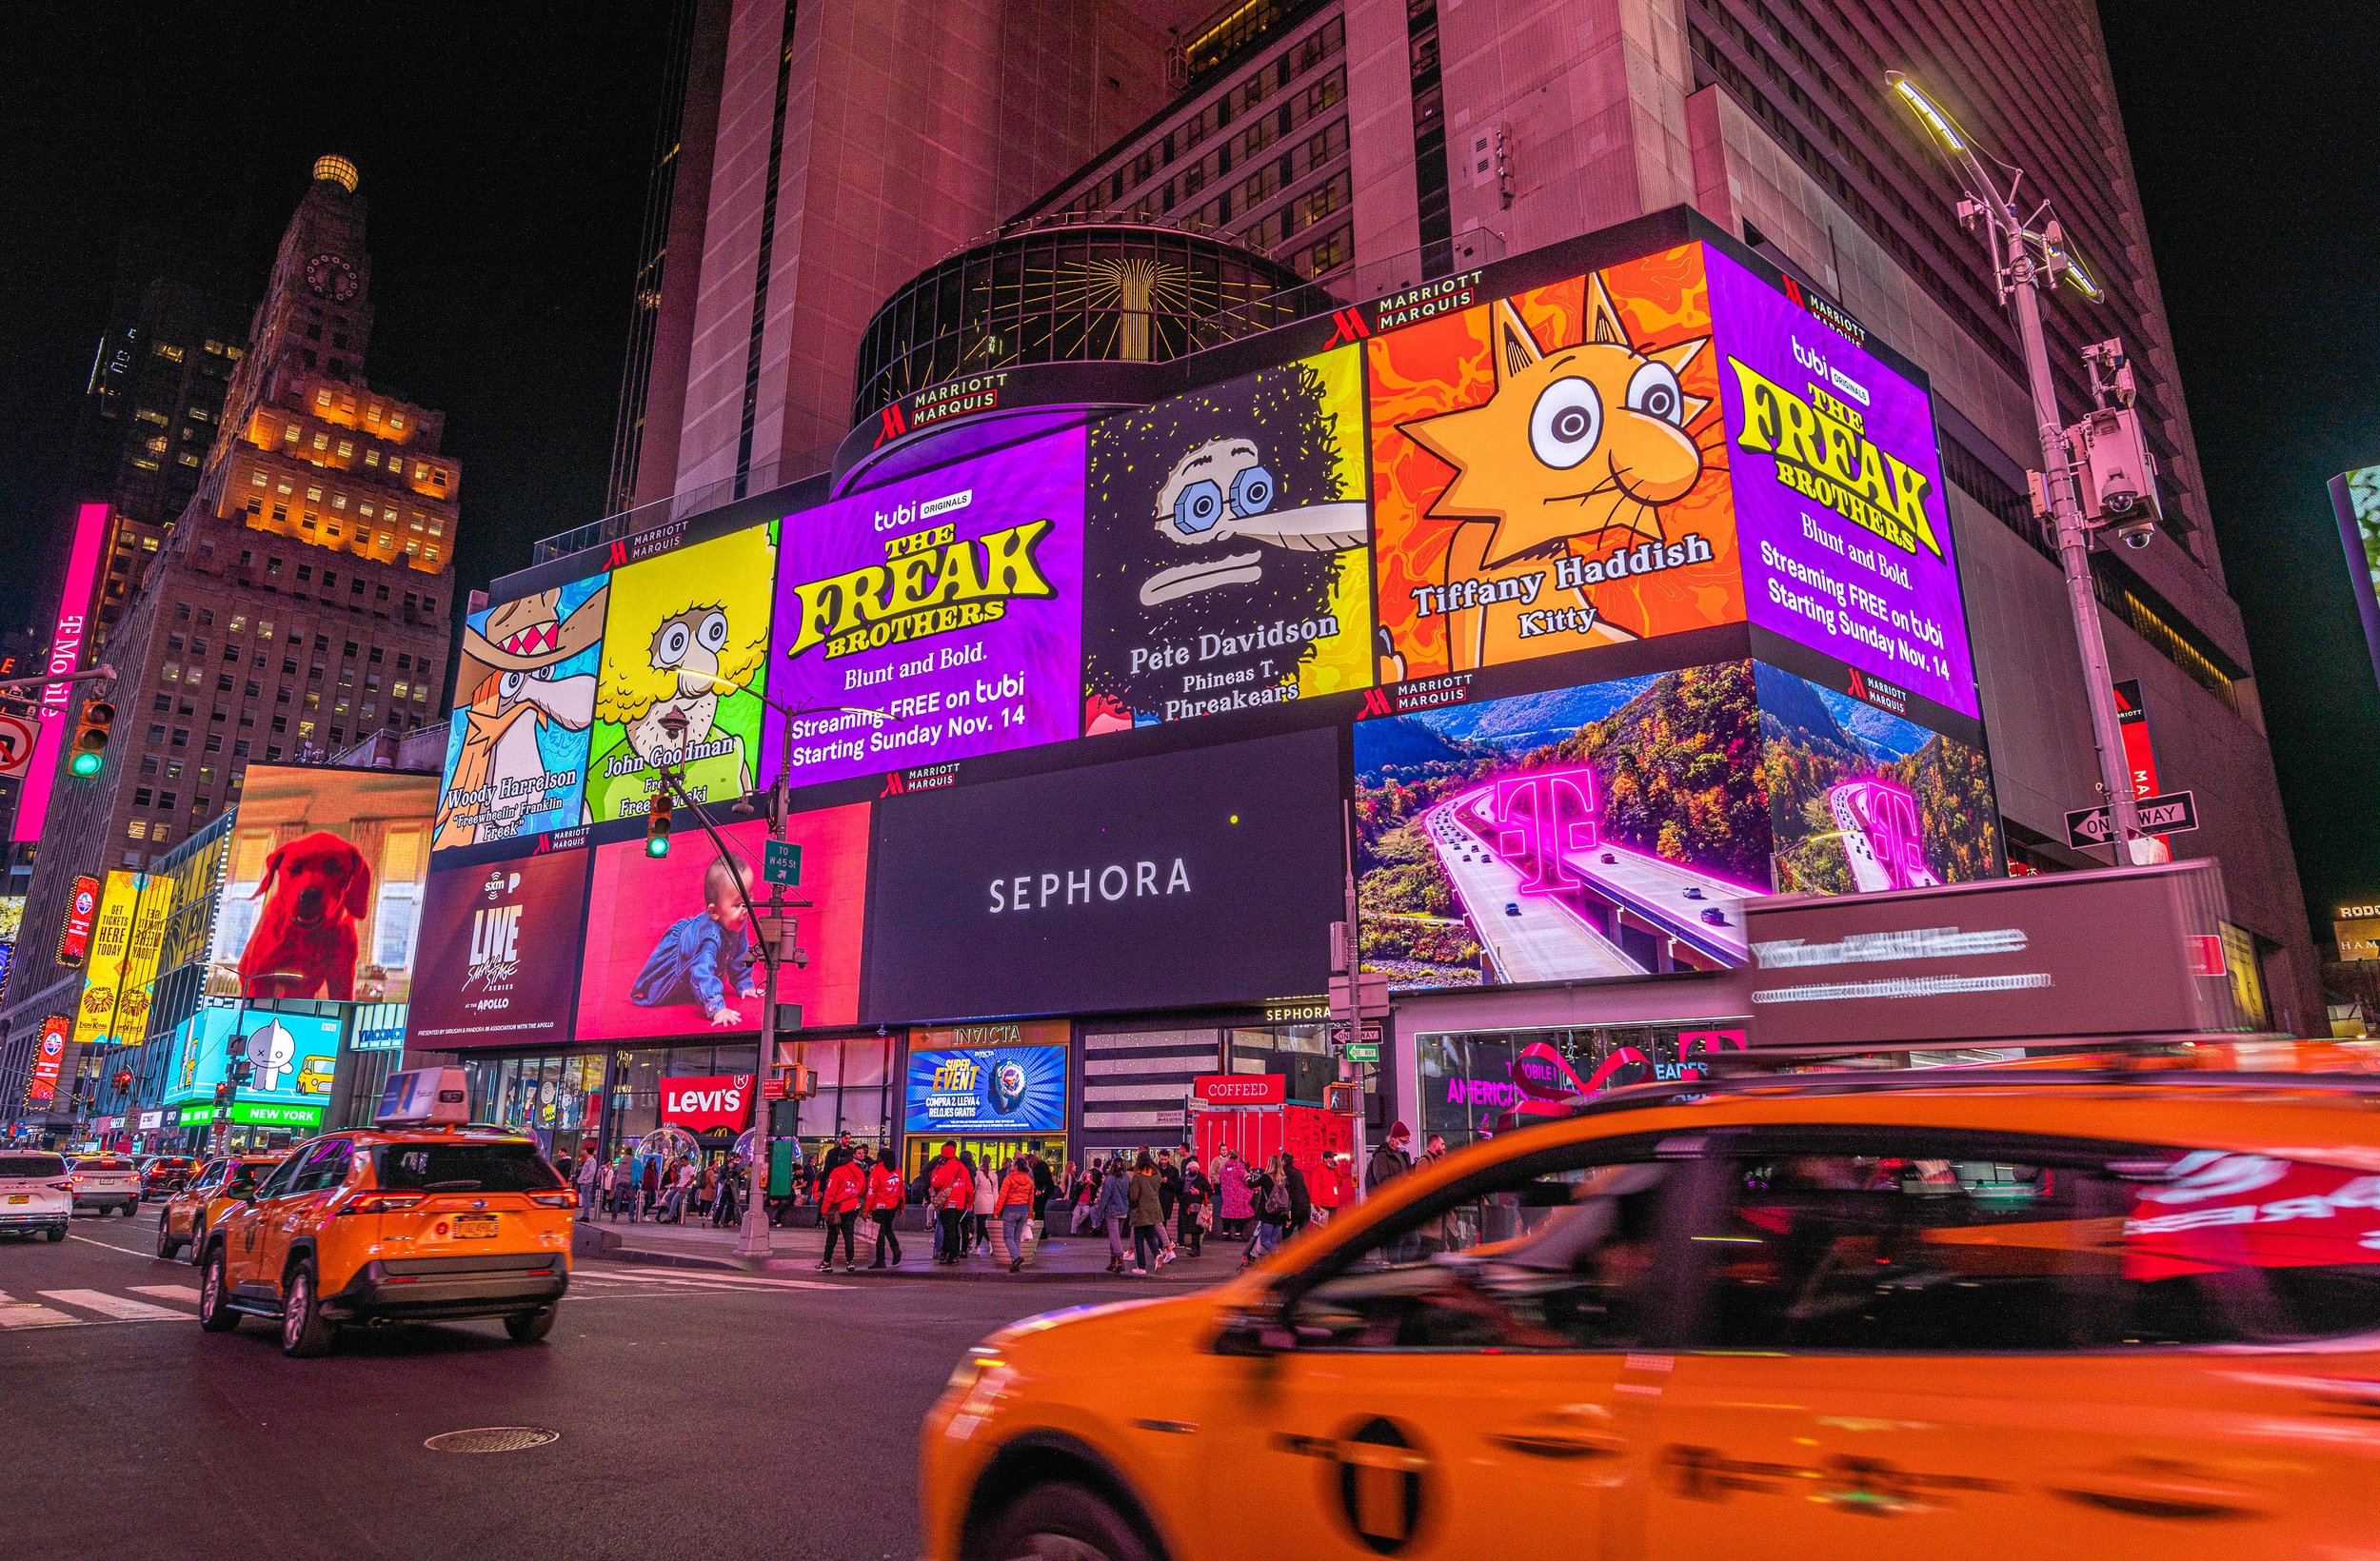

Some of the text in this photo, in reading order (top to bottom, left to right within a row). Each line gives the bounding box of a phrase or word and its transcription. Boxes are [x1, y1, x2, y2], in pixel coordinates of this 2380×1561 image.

[1380, 270, 1482, 312] MARRIOTT
[1380, 292, 1471, 329] MARQUIS
[1811, 293, 1866, 341] MARRIOTT
[1792, 334, 1867, 402] tubi ORIGINALS
[915, 373, 1007, 407] MARRIOTT
[914, 392, 994, 425] MARQUIS
[1807, 381, 1865, 435] THE
[1727, 354, 1943, 559] FREAK
[874, 495, 968, 532] tubi ORIGINALS
[1775, 460, 1917, 555] BROTHERS
[633, 536, 680, 558] MARQUIS
[634, 522, 688, 546] MARRIOTT
[884, 524, 956, 560] THE
[1800, 512, 1914, 590] Blunt and Bold.
[787, 519, 1052, 657] FREAK
[1411, 533, 1714, 619] Tiffany Haddish
[1760, 540, 1944, 650] Streaming FREE on tubi
[824, 599, 1005, 660] BROTHERS
[1517, 608, 1597, 640] Kitty
[1768, 577, 1950, 682] Starting Sunday Nov. 14
[1130, 615, 1339, 674] Pete Davidson
[843, 642, 987, 691] Blunt and Bold.
[1182, 660, 1279, 693] Phineas T.
[1398, 674, 1473, 695] MARRIOTT
[1398, 689, 1464, 709] MARQUIS
[1868, 677, 1906, 702] MARRIOTT
[792, 671, 1024, 741] Streaming FREE on tubi
[1165, 682, 1299, 721] Phreakears
[1870, 691, 1904, 713] MARQUIS
[2117, 710, 2142, 719] RRIOTT
[792, 704, 1024, 767] Starting Sunday Nov. 14
[604, 738, 733, 779] John Goodman
[908, 763, 960, 779] MARRIOTT
[447, 770, 577, 809] Woody Harrelson
[908, 775, 954, 791] MARQUIS
[519, 798, 563, 816] Franklin
[2087, 806, 2176, 834] ON WAY
[552, 838, 585, 849] MARQUIS
[554, 827, 590, 840] MARRIOTT
[769, 857, 796, 868] W 45 St
[779, 846, 788, 856] TO
[485, 879, 505, 892] sxm
[988, 858, 1191, 914] SEPHORA
[103, 916, 129, 927] TICKETS
[110, 905, 124, 916] GET
[97, 943, 122, 956] TODAY
[99, 927, 126, 944] HERE
[469, 904, 524, 965] LIVE
[462, 955, 501, 992] SMALL
[483, 959, 520, 992] STAGE
[478, 998, 508, 1010] APOLLO
[1266, 1007, 1331, 1021] SEPHORA
[359, 1028, 406, 1043] VIACOMC
[954, 1025, 1021, 1045] INVICTA
[933, 1066, 981, 1091] EVENT
[945, 1058, 971, 1072] SUPER
[925, 1097, 951, 1107] COMPRA
[957, 1097, 975, 1106] LLEVA
[975, 1097, 981, 1106] 4
[1208, 1083, 1268, 1097] COFFEED
[249, 1108, 314, 1121] NEW YORK
[929, 1107, 976, 1117] RELOJES GRATIS
